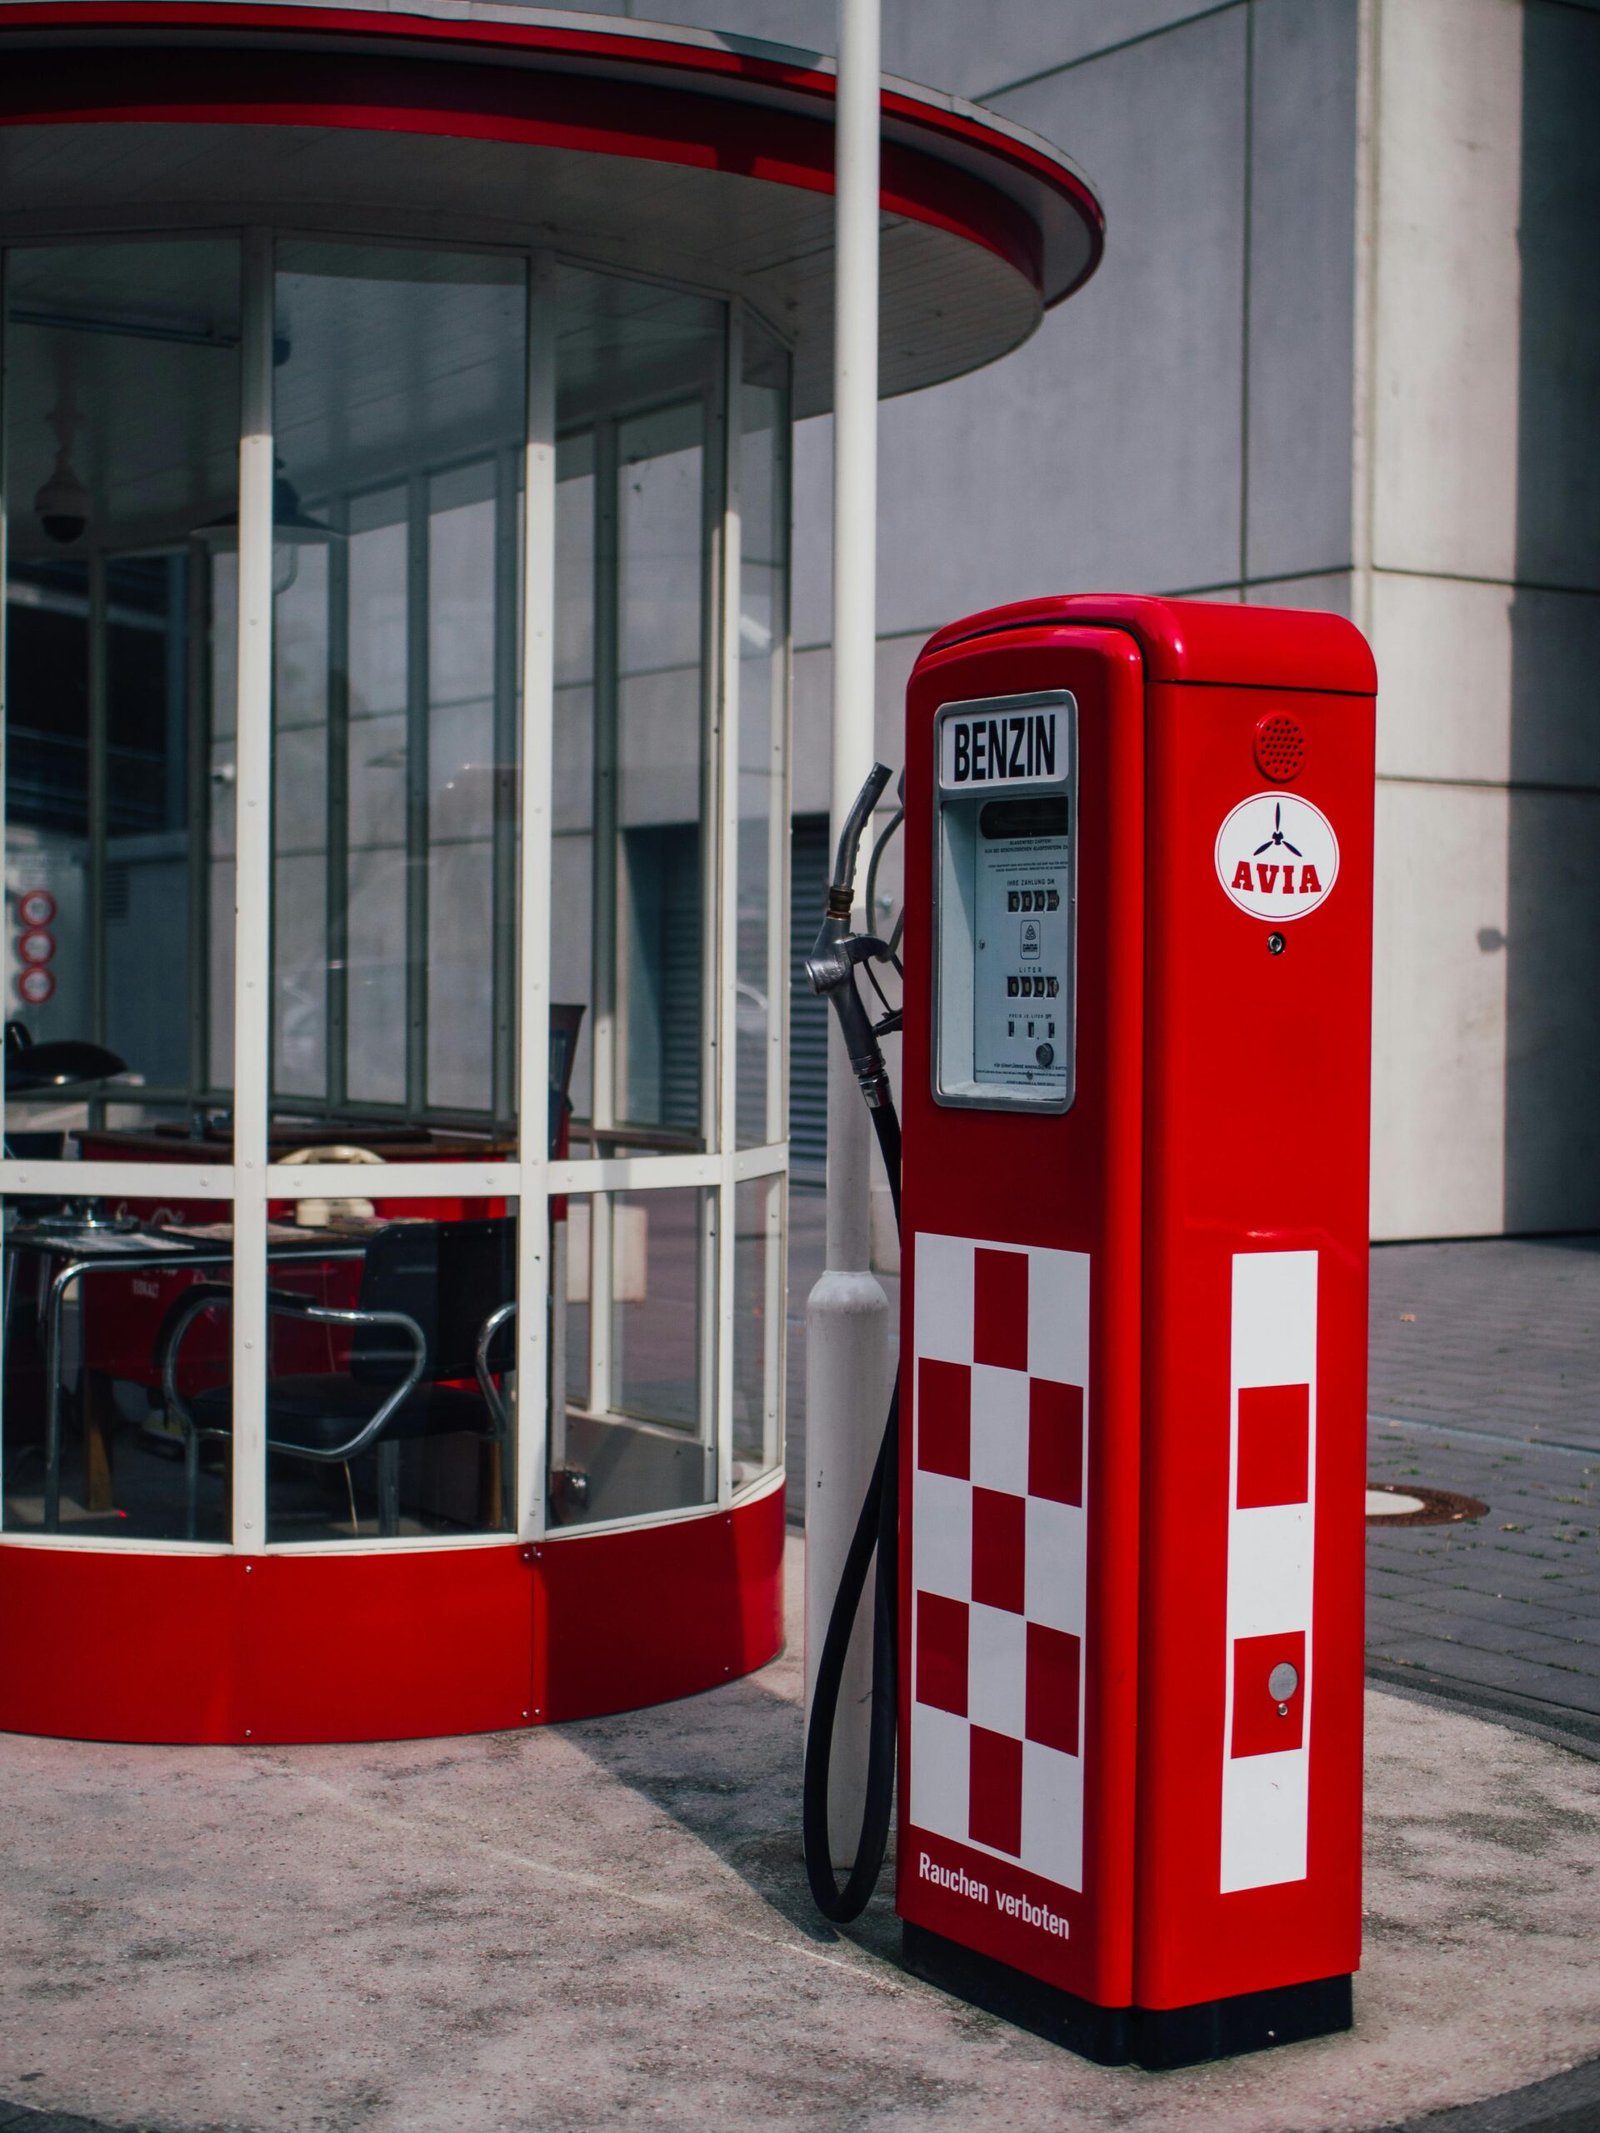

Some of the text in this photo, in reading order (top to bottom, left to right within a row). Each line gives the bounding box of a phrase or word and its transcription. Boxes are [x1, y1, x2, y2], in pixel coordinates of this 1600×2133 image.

[954, 714, 1055, 782] BENZIN
[1231, 860, 1322, 894] AVIA
[1019, 966, 1042, 974] LITER
[919, 1851, 1070, 1940] Rauchen verboten
